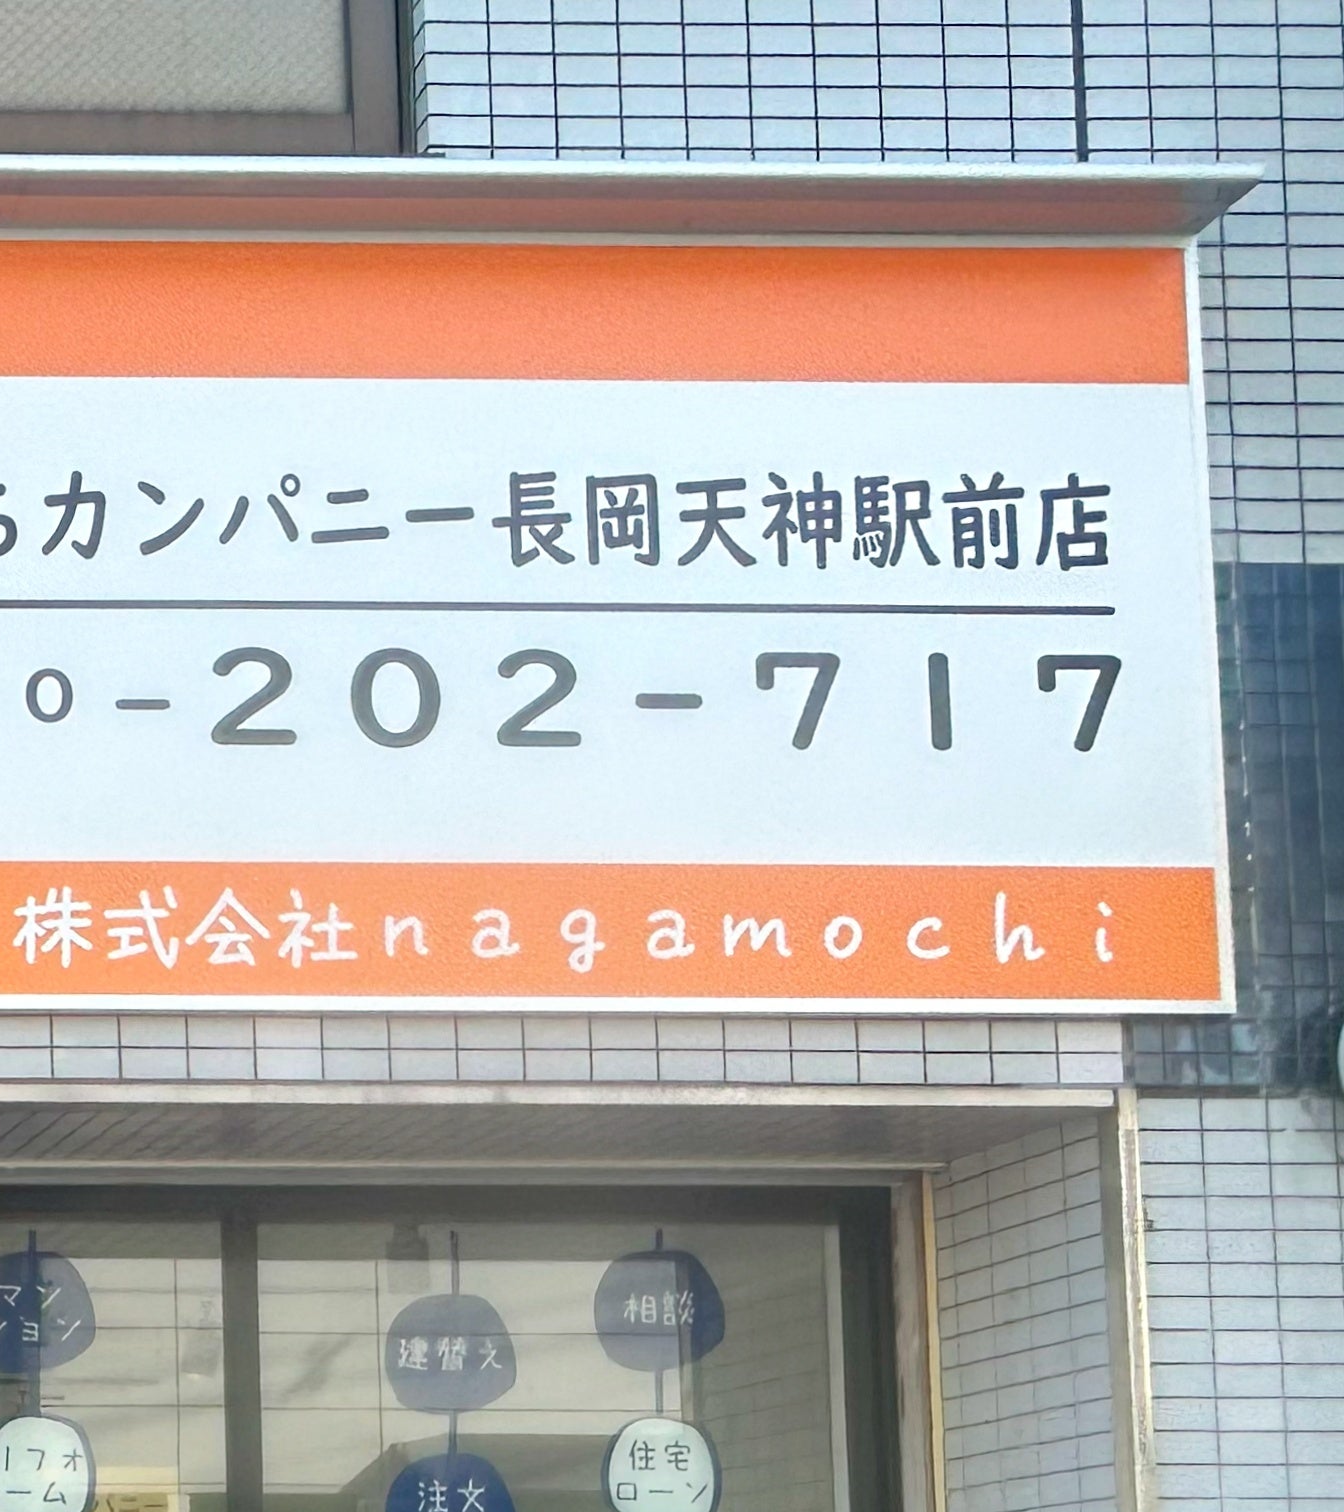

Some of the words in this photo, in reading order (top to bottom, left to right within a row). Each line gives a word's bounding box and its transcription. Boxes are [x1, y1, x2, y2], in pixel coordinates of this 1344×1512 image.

[623, 1290, 696, 1326] 相談
[397, 1335, 503, 1372] 建替え
[627, 1439, 691, 1473] 住宅
[418, 1479, 486, 1512] 注文
[615, 1482, 708, 1504] ローン
